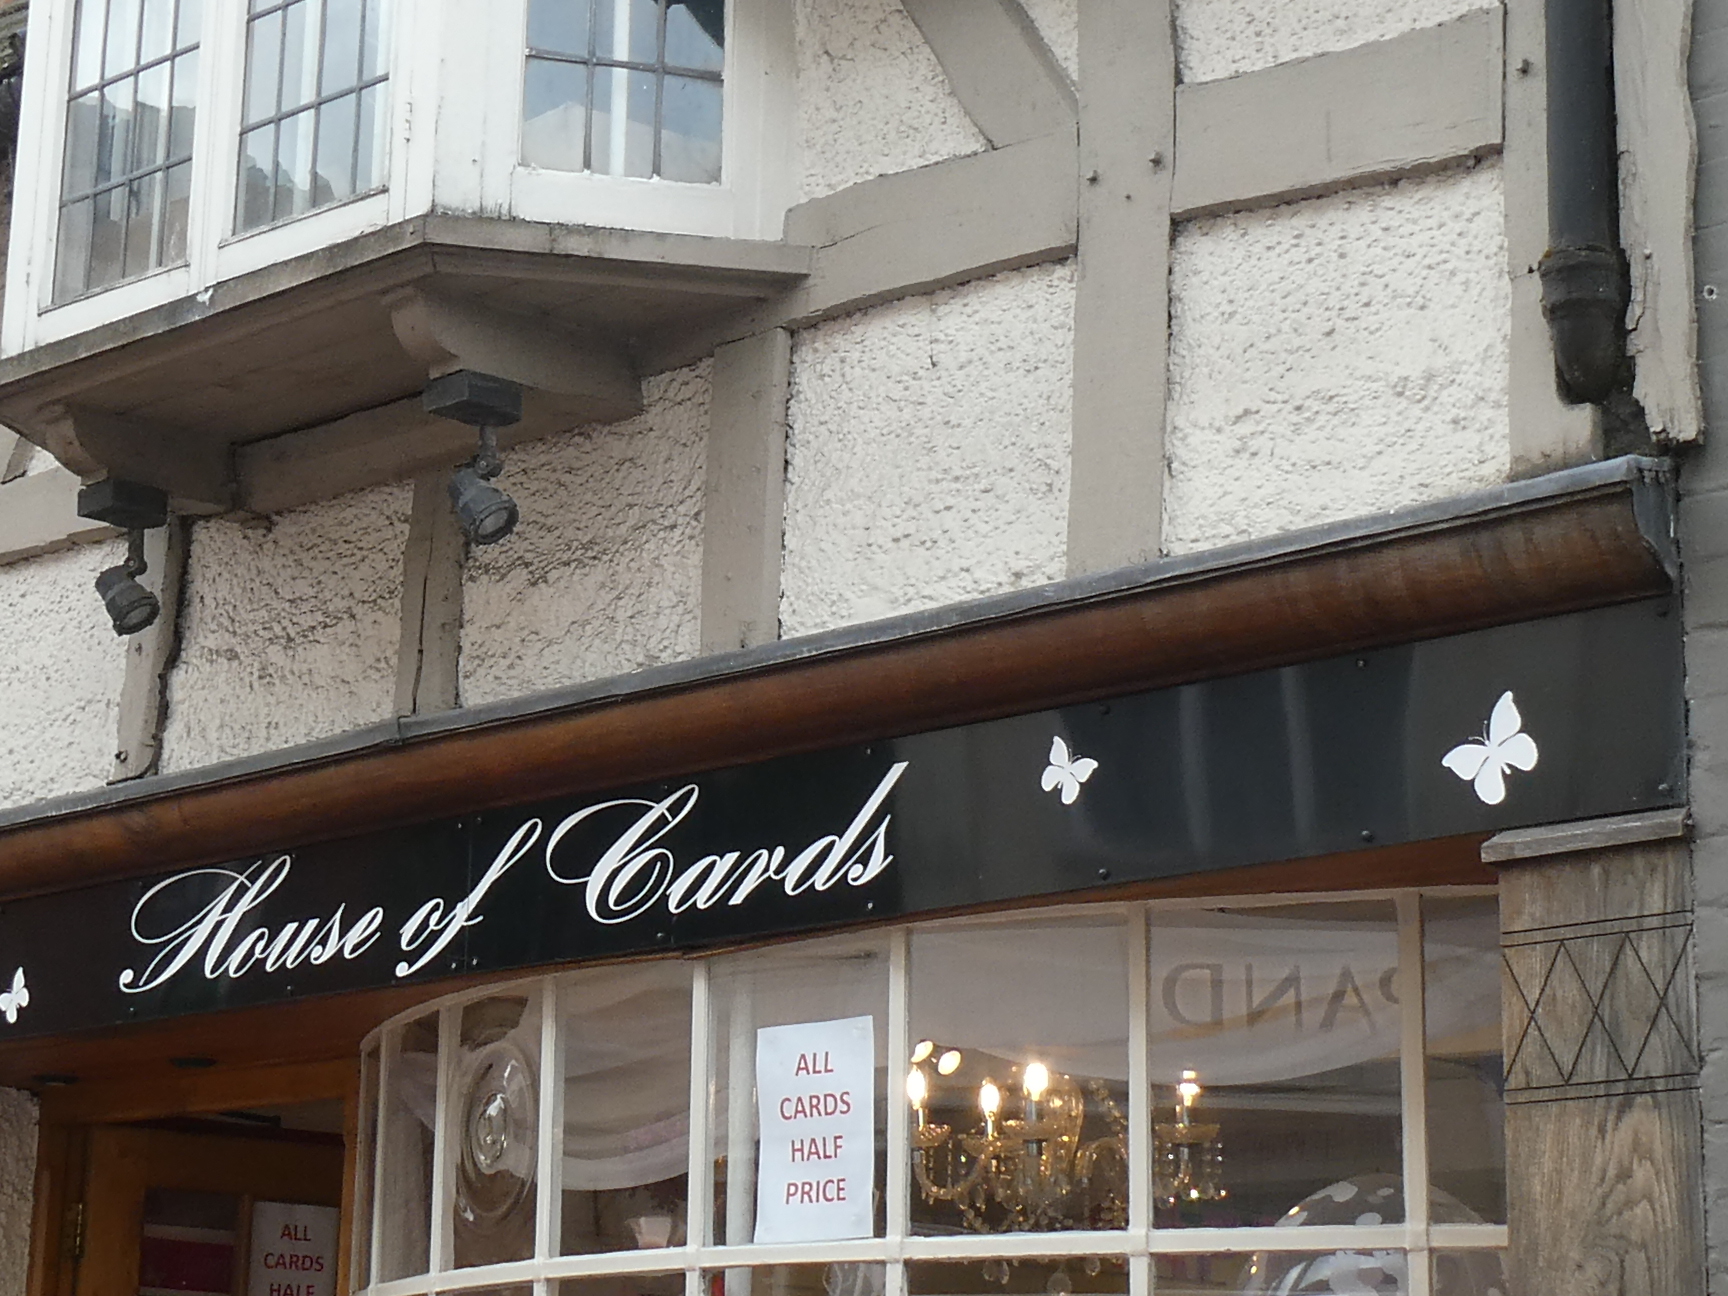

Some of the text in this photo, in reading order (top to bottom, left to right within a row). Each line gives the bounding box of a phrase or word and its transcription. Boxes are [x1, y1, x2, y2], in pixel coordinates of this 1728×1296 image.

[119, 760, 910, 994] House of Cards
[794, 1050, 834, 1077] ALL
[779, 1091, 852, 1121] CARDS
[790, 1135, 844, 1163] HALF
[785, 1178, 847, 1205] PRICE
[280, 1223, 312, 1242] ALL
[263, 1252, 324, 1272] CARDS
